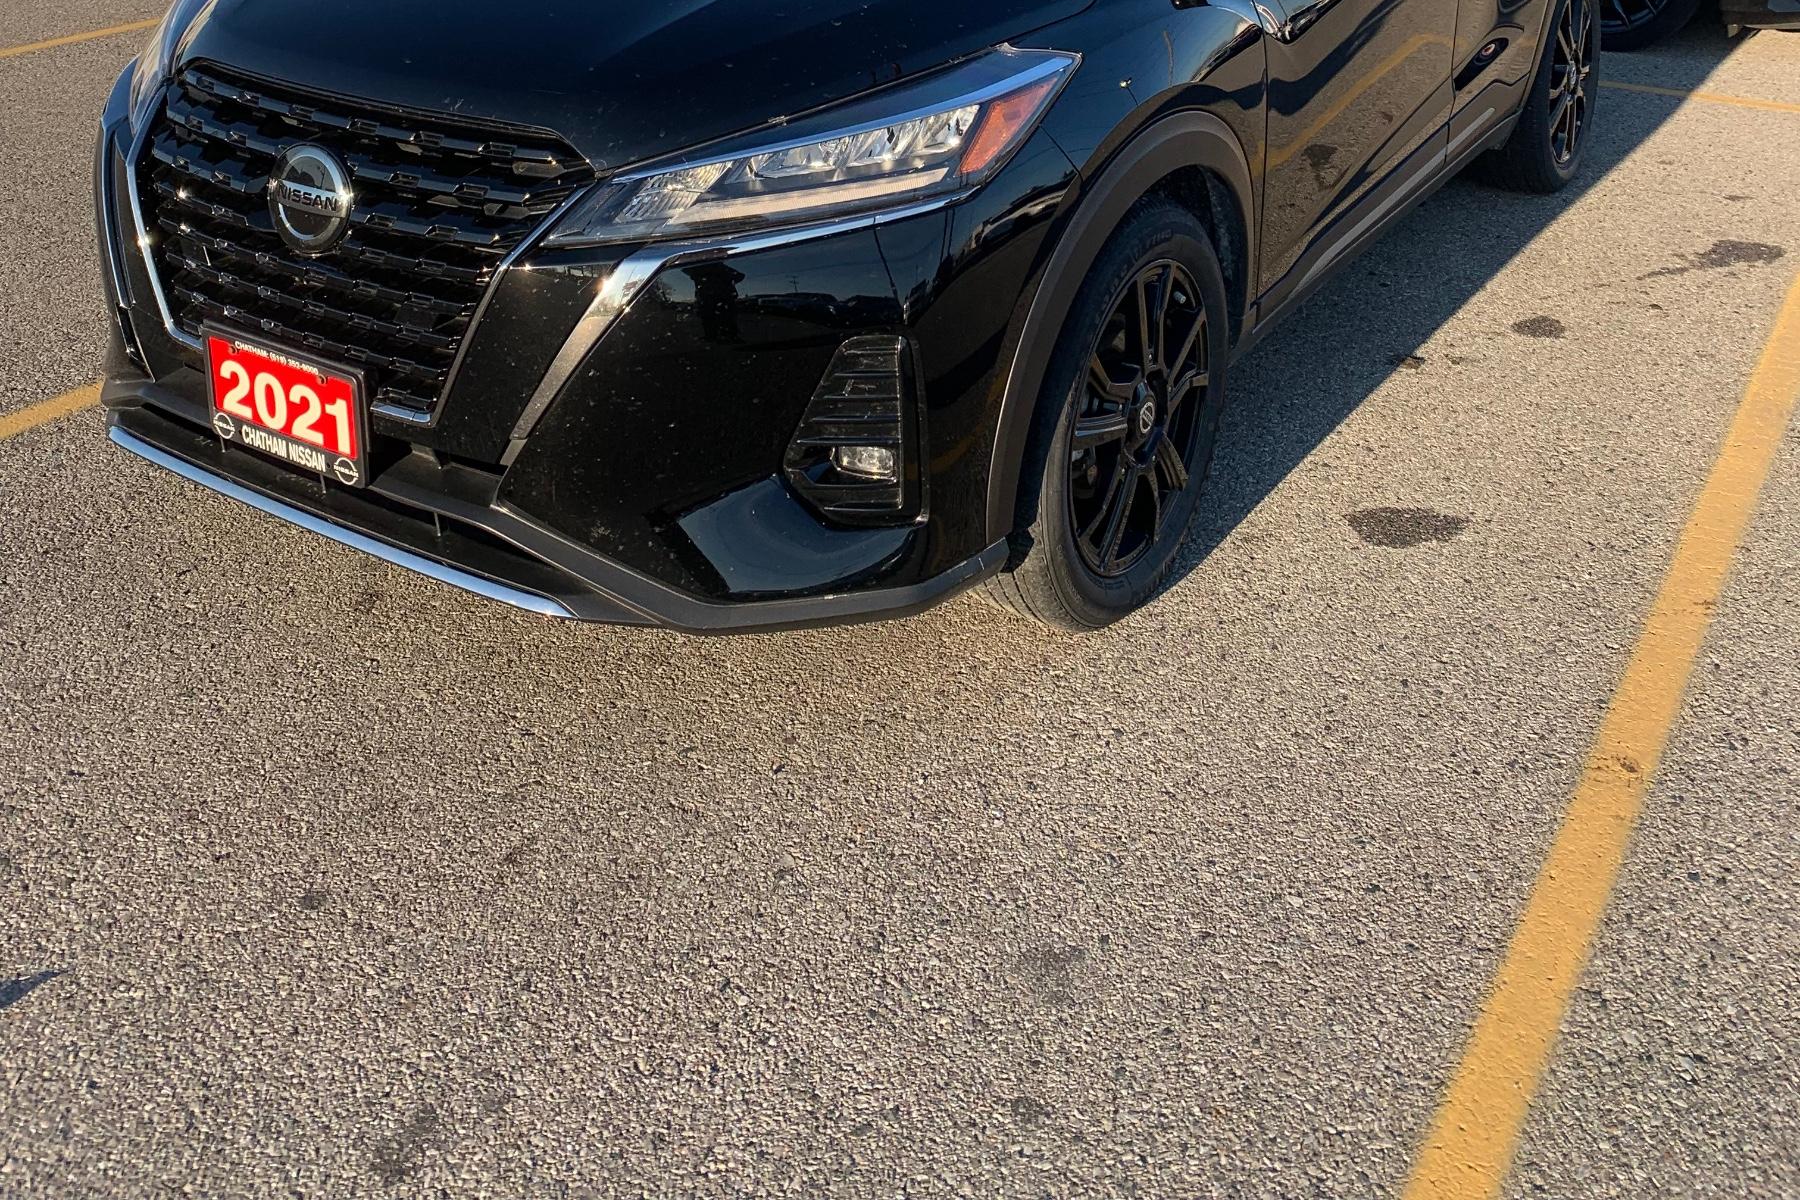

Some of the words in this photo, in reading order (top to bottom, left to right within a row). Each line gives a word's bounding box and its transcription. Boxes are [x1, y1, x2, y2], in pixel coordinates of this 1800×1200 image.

[278, 184, 338, 212] NISSAN
[219, 359, 351, 456] 2021
[241, 425, 287, 459] CHATHAM
[288, 442, 327, 473] NISSAN
